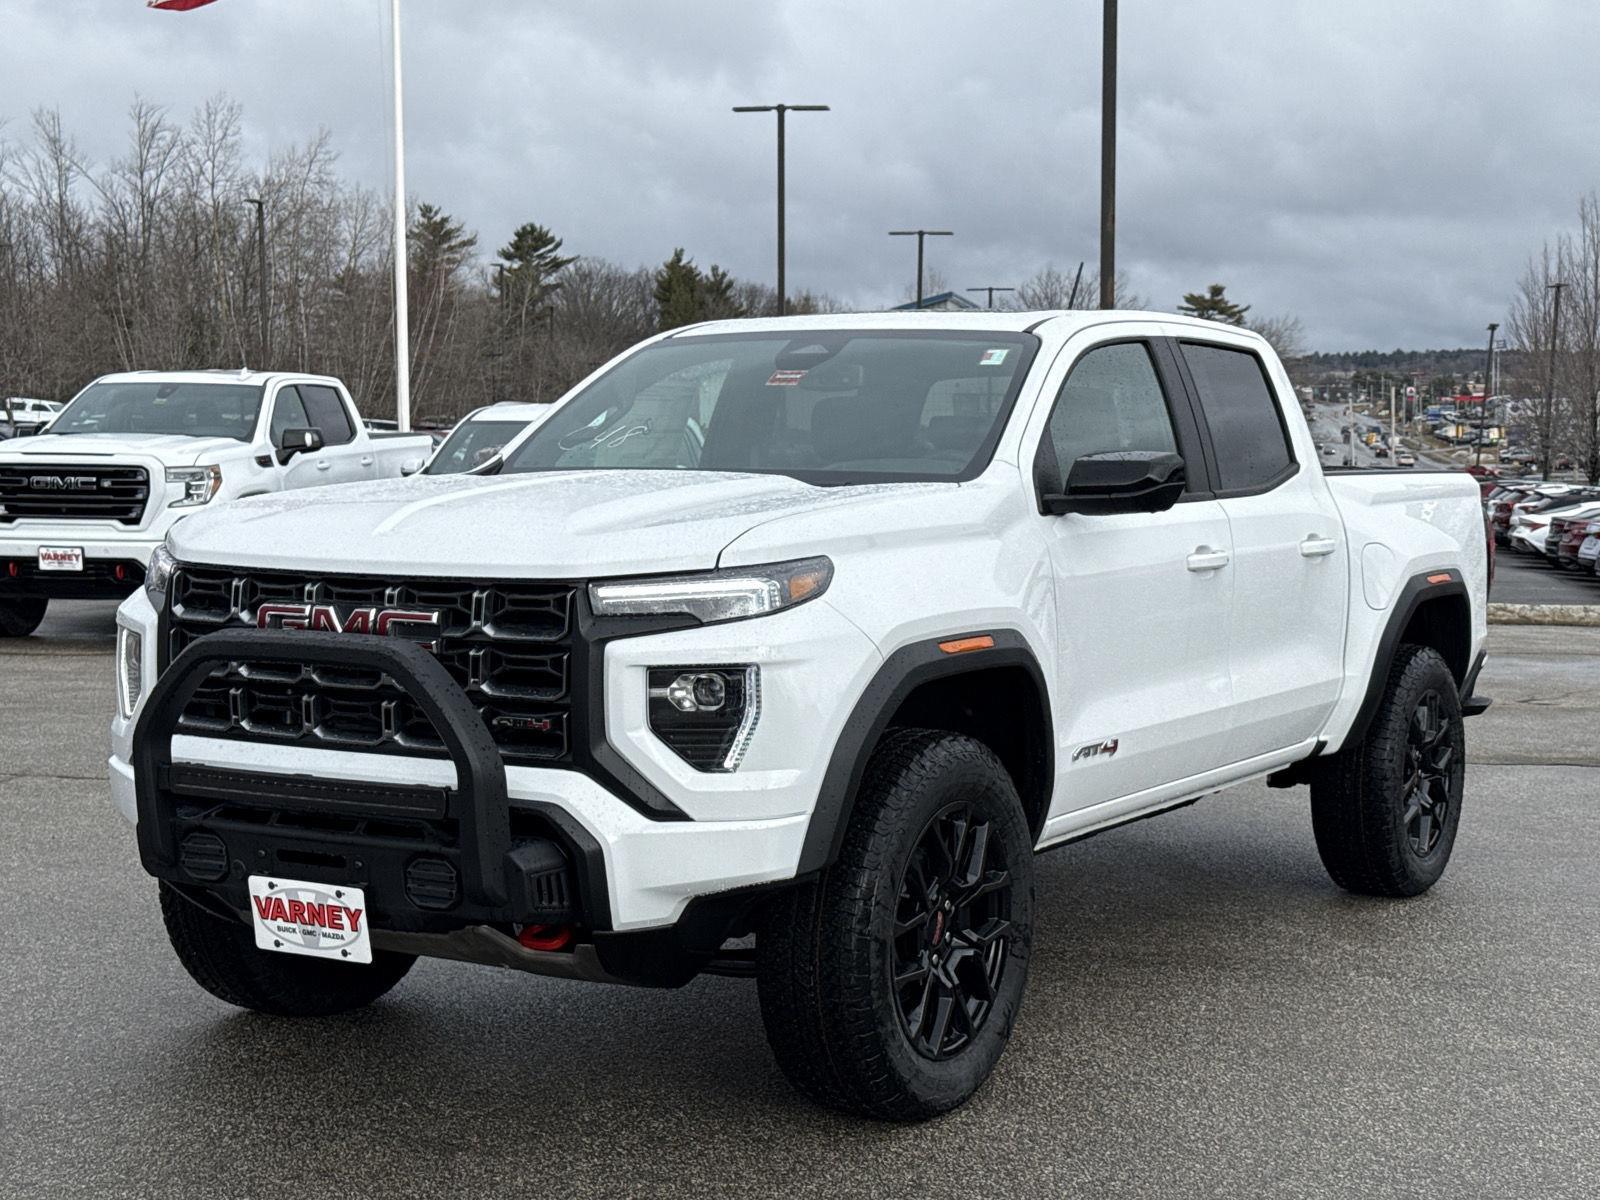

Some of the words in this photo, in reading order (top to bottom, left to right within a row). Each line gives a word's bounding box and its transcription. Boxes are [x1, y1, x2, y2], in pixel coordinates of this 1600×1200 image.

[30, 476, 97, 490] GMC
[41, 552, 81, 561] VARNEY
[257, 603, 440, 653] GMC
[1072, 738, 1119, 762] AT4
[253, 895, 363, 932] VARNEY
[277, 925, 298, 934] BUICK
[302, 928, 317, 937] GMC
[321, 931, 346, 941] MAZDA
